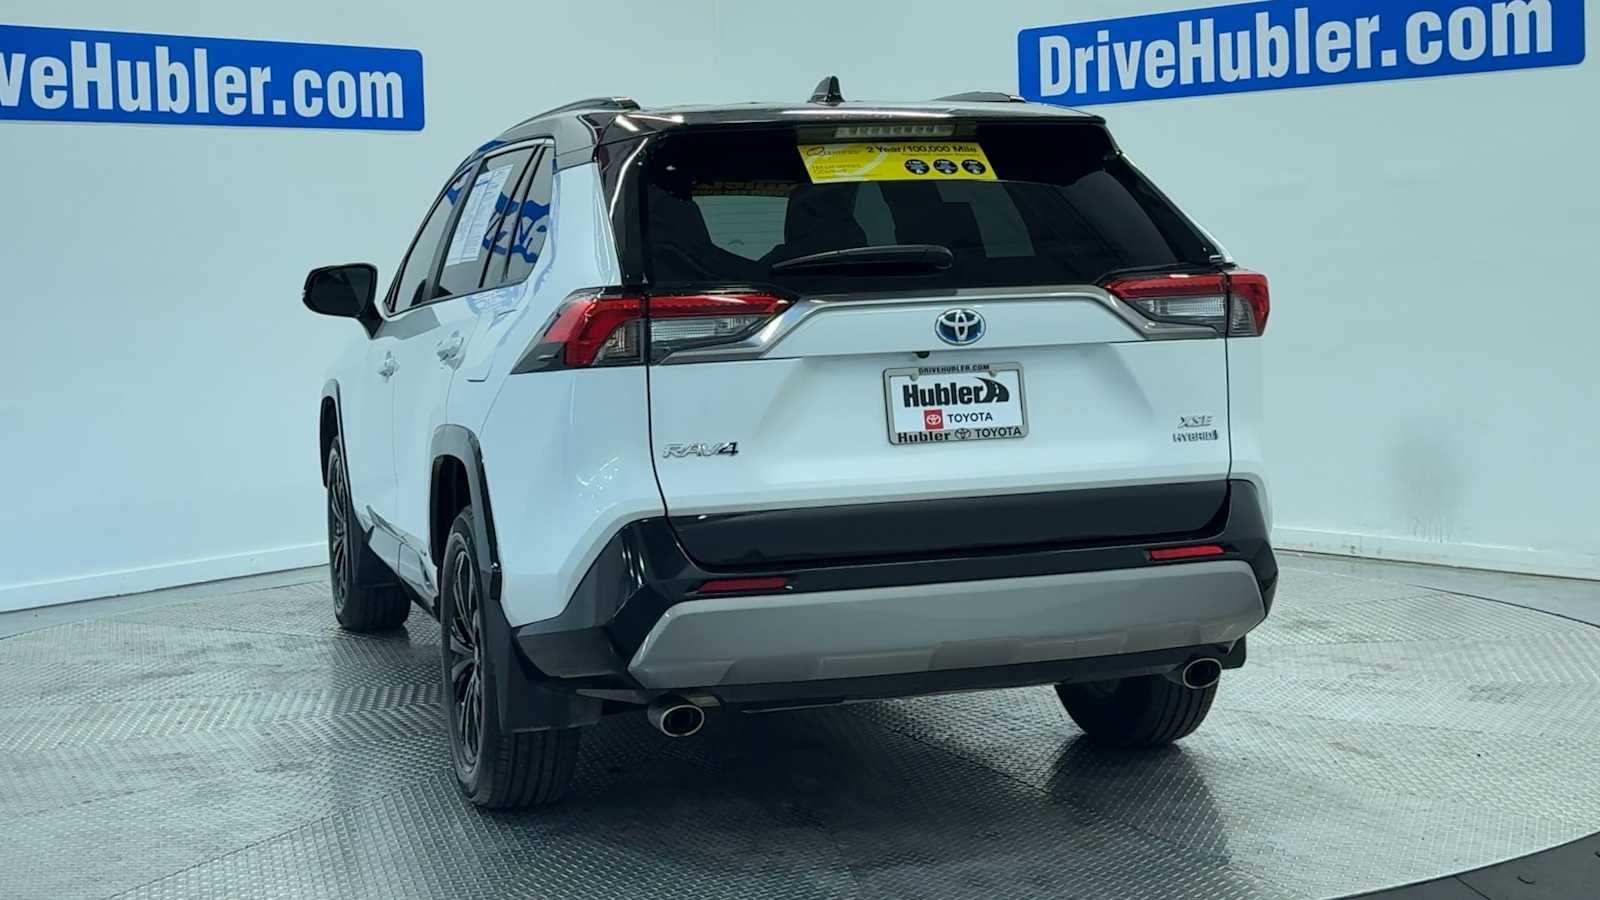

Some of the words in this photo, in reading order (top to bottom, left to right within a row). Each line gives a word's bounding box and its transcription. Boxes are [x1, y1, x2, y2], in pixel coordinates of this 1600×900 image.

[1039, 0, 1553, 97] DriveHubler.com
[0, 40, 405, 120] veHubler.com
[918, 364, 990, 374] DRIVEHUBLER.COM
[902, 382, 984, 408] Hubler
[947, 412, 993, 424] TOYOTA
[897, 431, 951, 443] Hubler
[974, 427, 1022, 438] TOYOTA
[662, 441, 739, 458] RAV4
